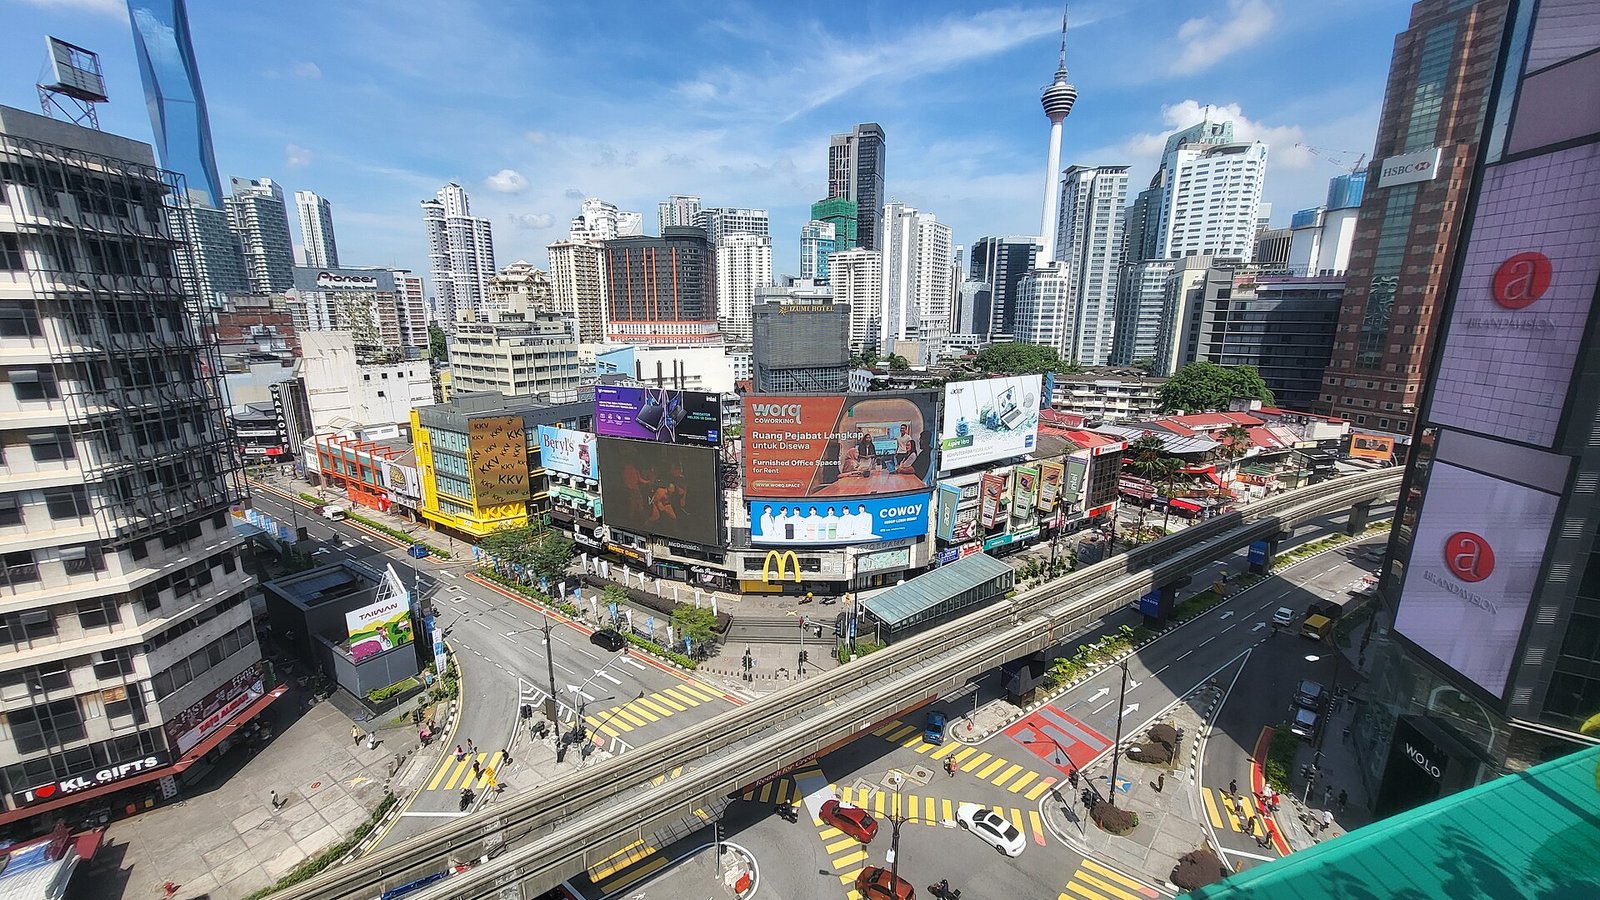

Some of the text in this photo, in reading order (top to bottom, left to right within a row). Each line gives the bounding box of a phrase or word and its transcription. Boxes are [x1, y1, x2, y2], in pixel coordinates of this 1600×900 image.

[1383, 164, 1414, 177] HSBC
[317, 272, 377, 283] Pioneer
[272, 393, 289, 443] KARAOKE
[752, 403, 802, 425] worq
[489, 426, 503, 438] KKV
[752, 431, 864, 442] Ruang Pejabat Lengkap
[485, 443, 497, 453] KKV
[500, 443, 510, 456] KKV
[543, 434, 575, 455] Beryl's
[752, 442, 810, 450] untuk Disewa
[479, 456, 500, 474] KKV
[752, 459, 790, 467] Furnished
[480, 479, 495, 489] KKV
[498, 475, 523, 484] KKV
[1070, 473, 1078, 492] intel
[486, 504, 520, 517] KKV
[880, 504, 922, 518] coway
[943, 503, 951, 526] acer
[668, 541, 701, 550] McDonald's
[1424, 570, 1499, 615] BRANDAVISION
[358, 602, 398, 620] TAIWAN
[1406, 742, 1440, 778] WOLO
[756, 753, 817, 786] Reach for Great
[25, 756, 158, 802] I KL GIFTS
